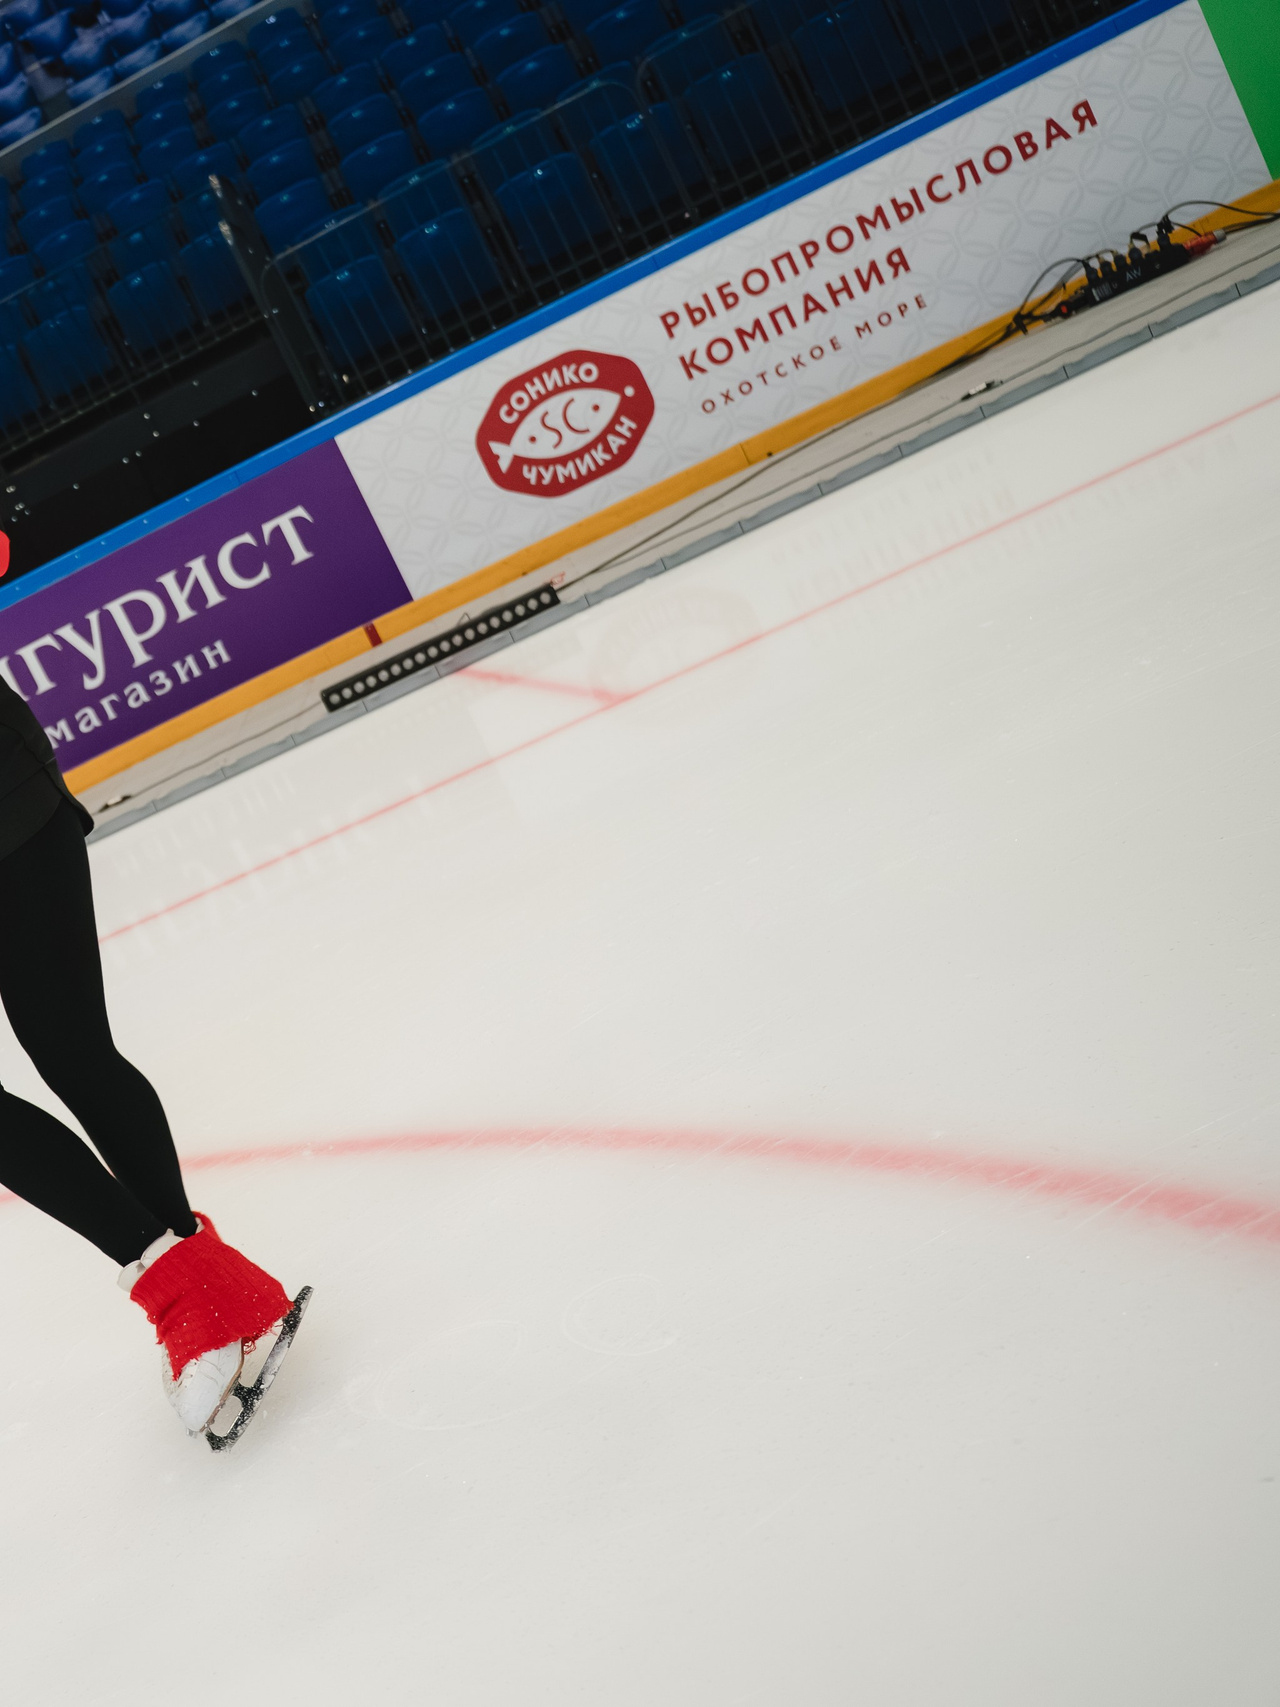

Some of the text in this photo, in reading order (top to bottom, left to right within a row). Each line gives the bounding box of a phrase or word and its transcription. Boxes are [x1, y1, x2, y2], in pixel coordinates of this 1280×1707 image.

[659, 98, 1098, 340] РЫБОПРОМЫСЛОВАЯ
[679, 247, 912, 381] КОМПАНИЯ
[701, 294, 928, 413] ОХОТСКОЕ МОРЕ
[499, 362, 599, 424] СОНИКО
[522, 415, 637, 485] ЧУМИКАН
[44, 640, 231, 749] магазин
